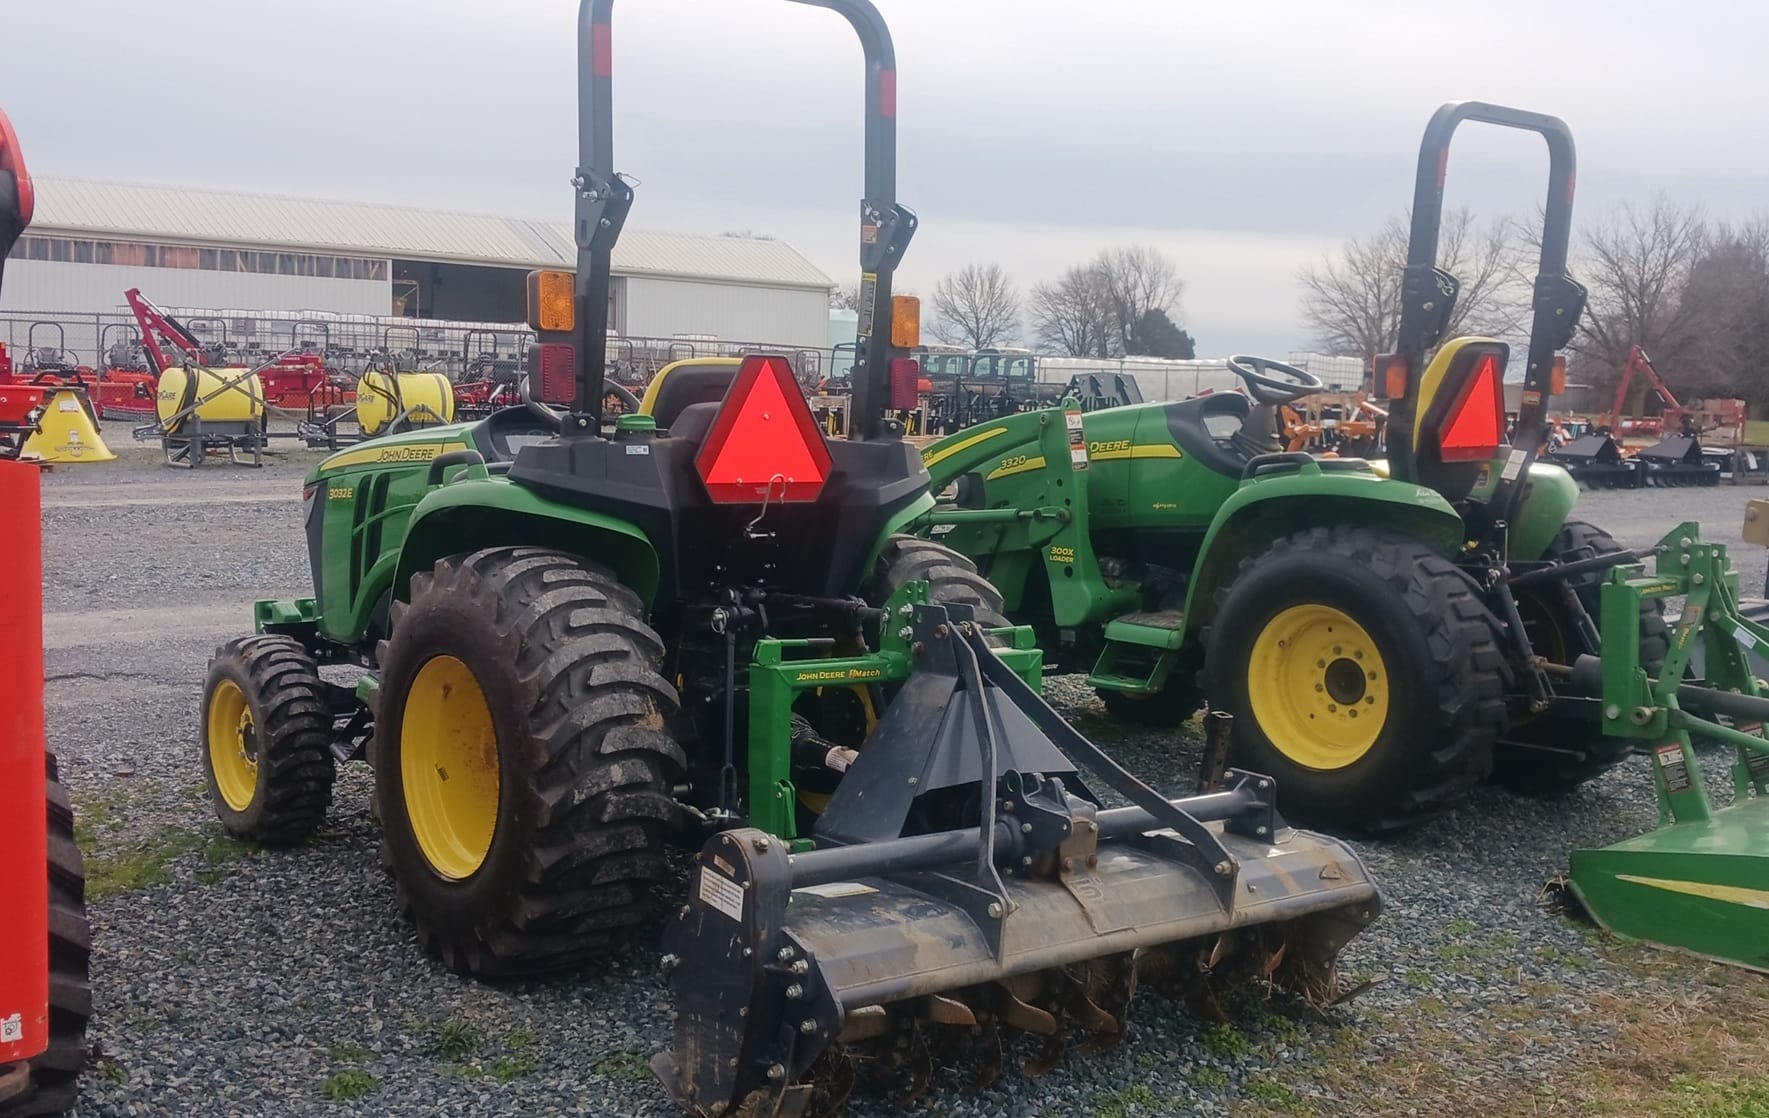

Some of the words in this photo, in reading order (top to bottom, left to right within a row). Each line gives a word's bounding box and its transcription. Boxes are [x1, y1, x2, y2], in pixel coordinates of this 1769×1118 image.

[1090, 440, 1131, 452] DEERE
[376, 448, 401, 462] JOHN
[401, 447, 435, 460] DEERE
[1001, 455, 1026, 470] 3320
[328, 487, 353, 500] 3032E
[1050, 546, 1074, 556] 300X
[1049, 555, 1074, 564] LOADER
[796, 672, 819, 681] JOHN
[819, 671, 846, 680] DEERE
